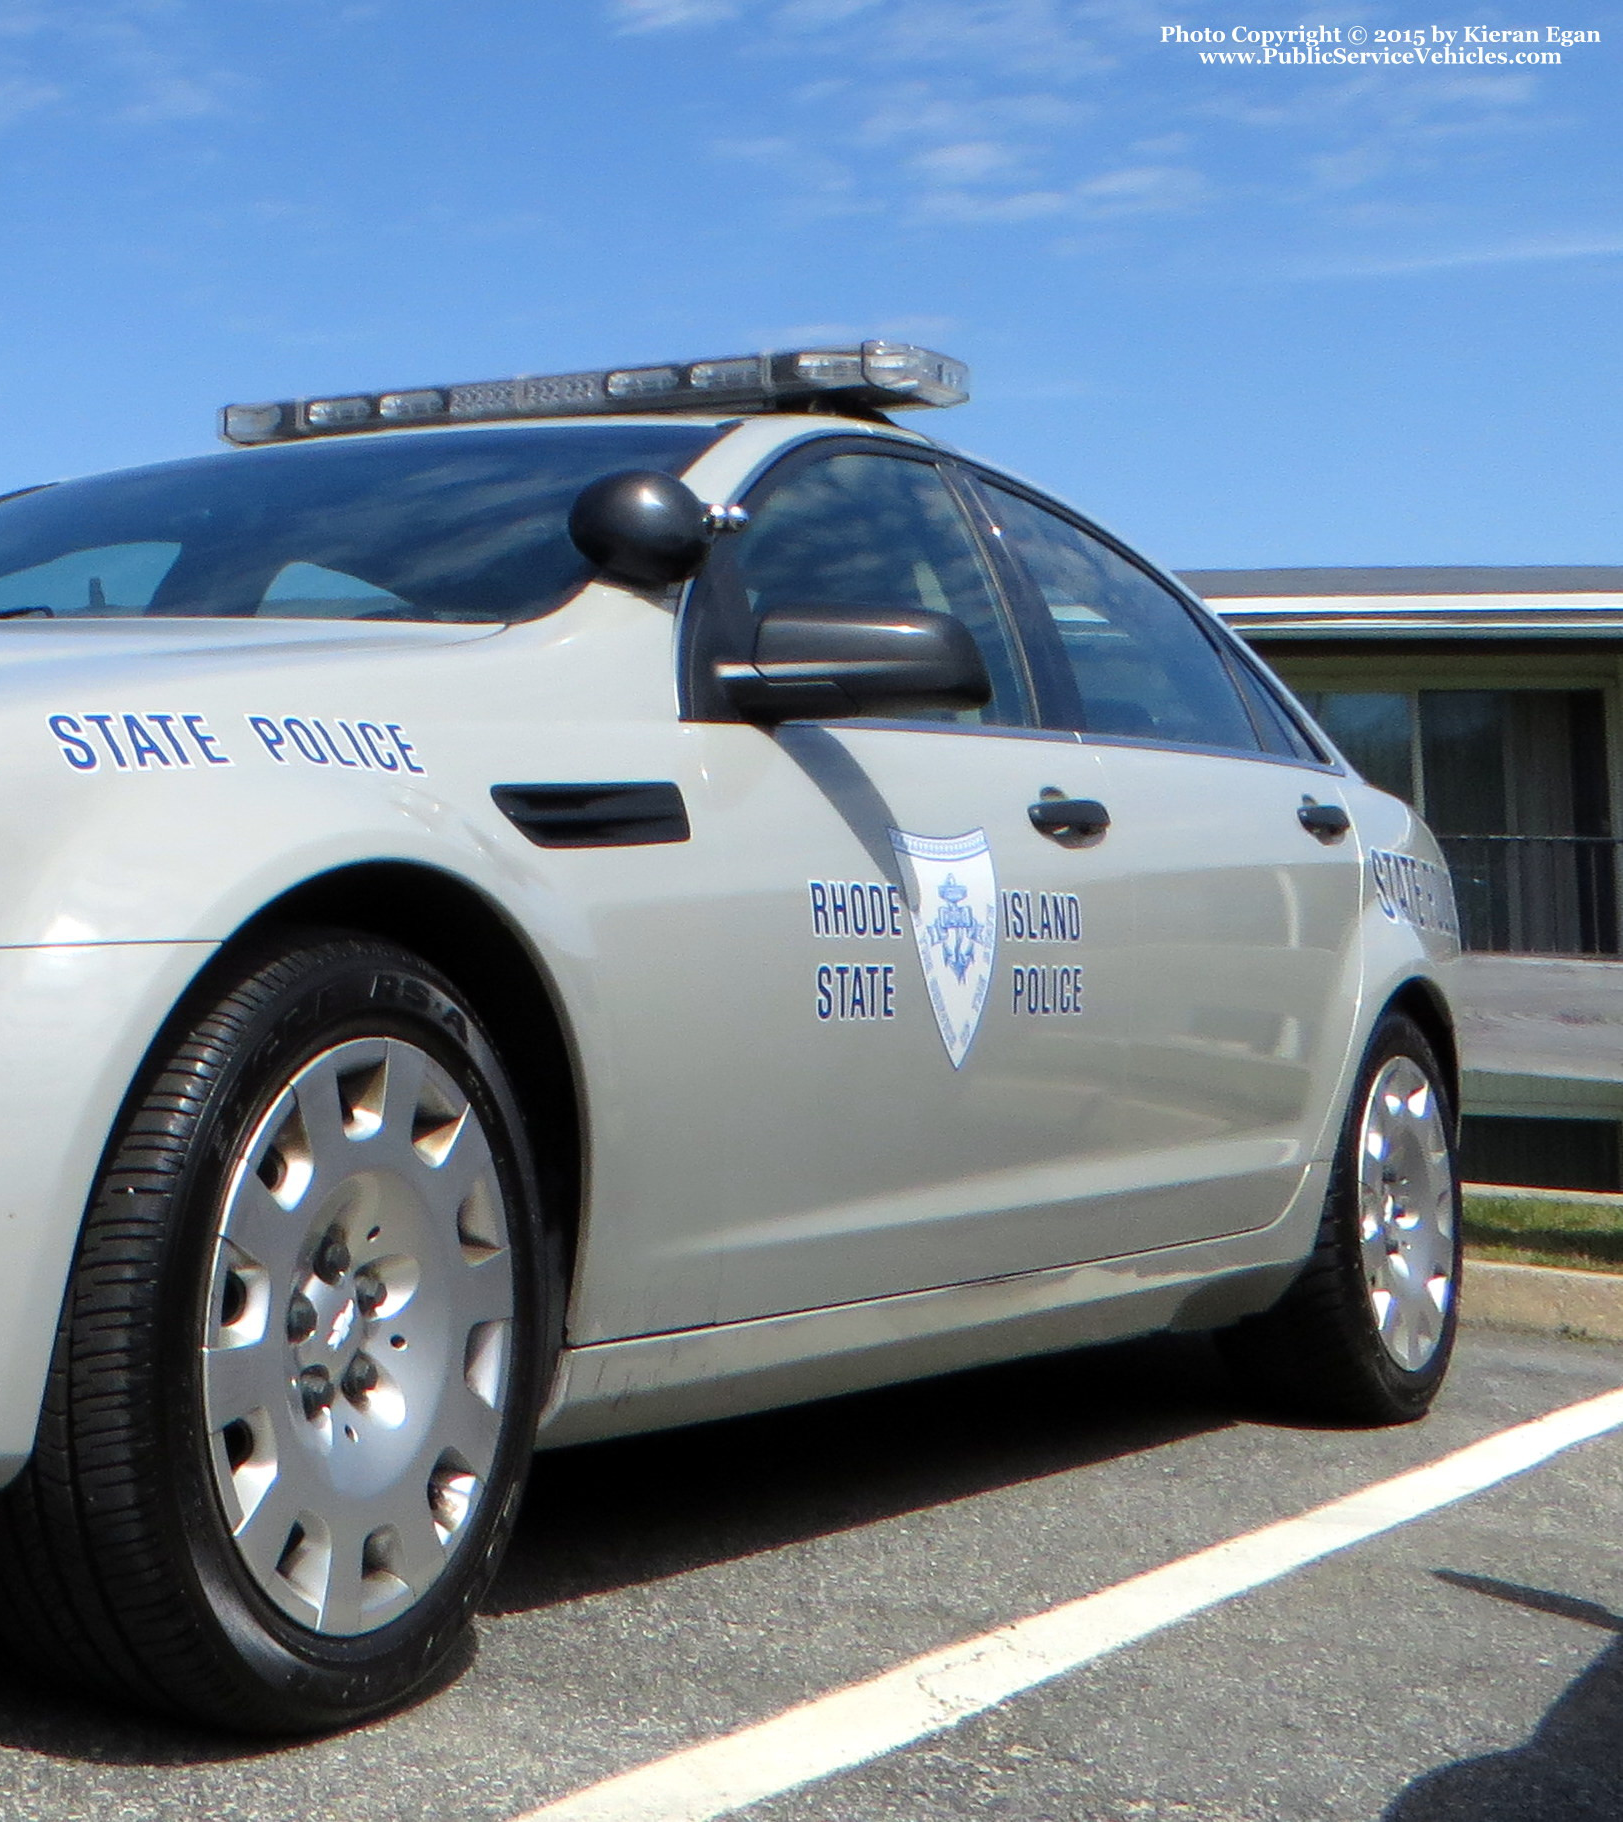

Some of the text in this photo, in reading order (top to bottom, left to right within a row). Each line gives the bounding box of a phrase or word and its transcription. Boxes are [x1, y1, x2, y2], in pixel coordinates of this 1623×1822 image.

[46, 711, 429, 778] STATE POLICE
[808, 880, 903, 938] RHODE
[1001, 889, 1082, 942] ISLAND
[815, 963, 896, 1021] STATE
[1011, 965, 1083, 1015] POLICE
